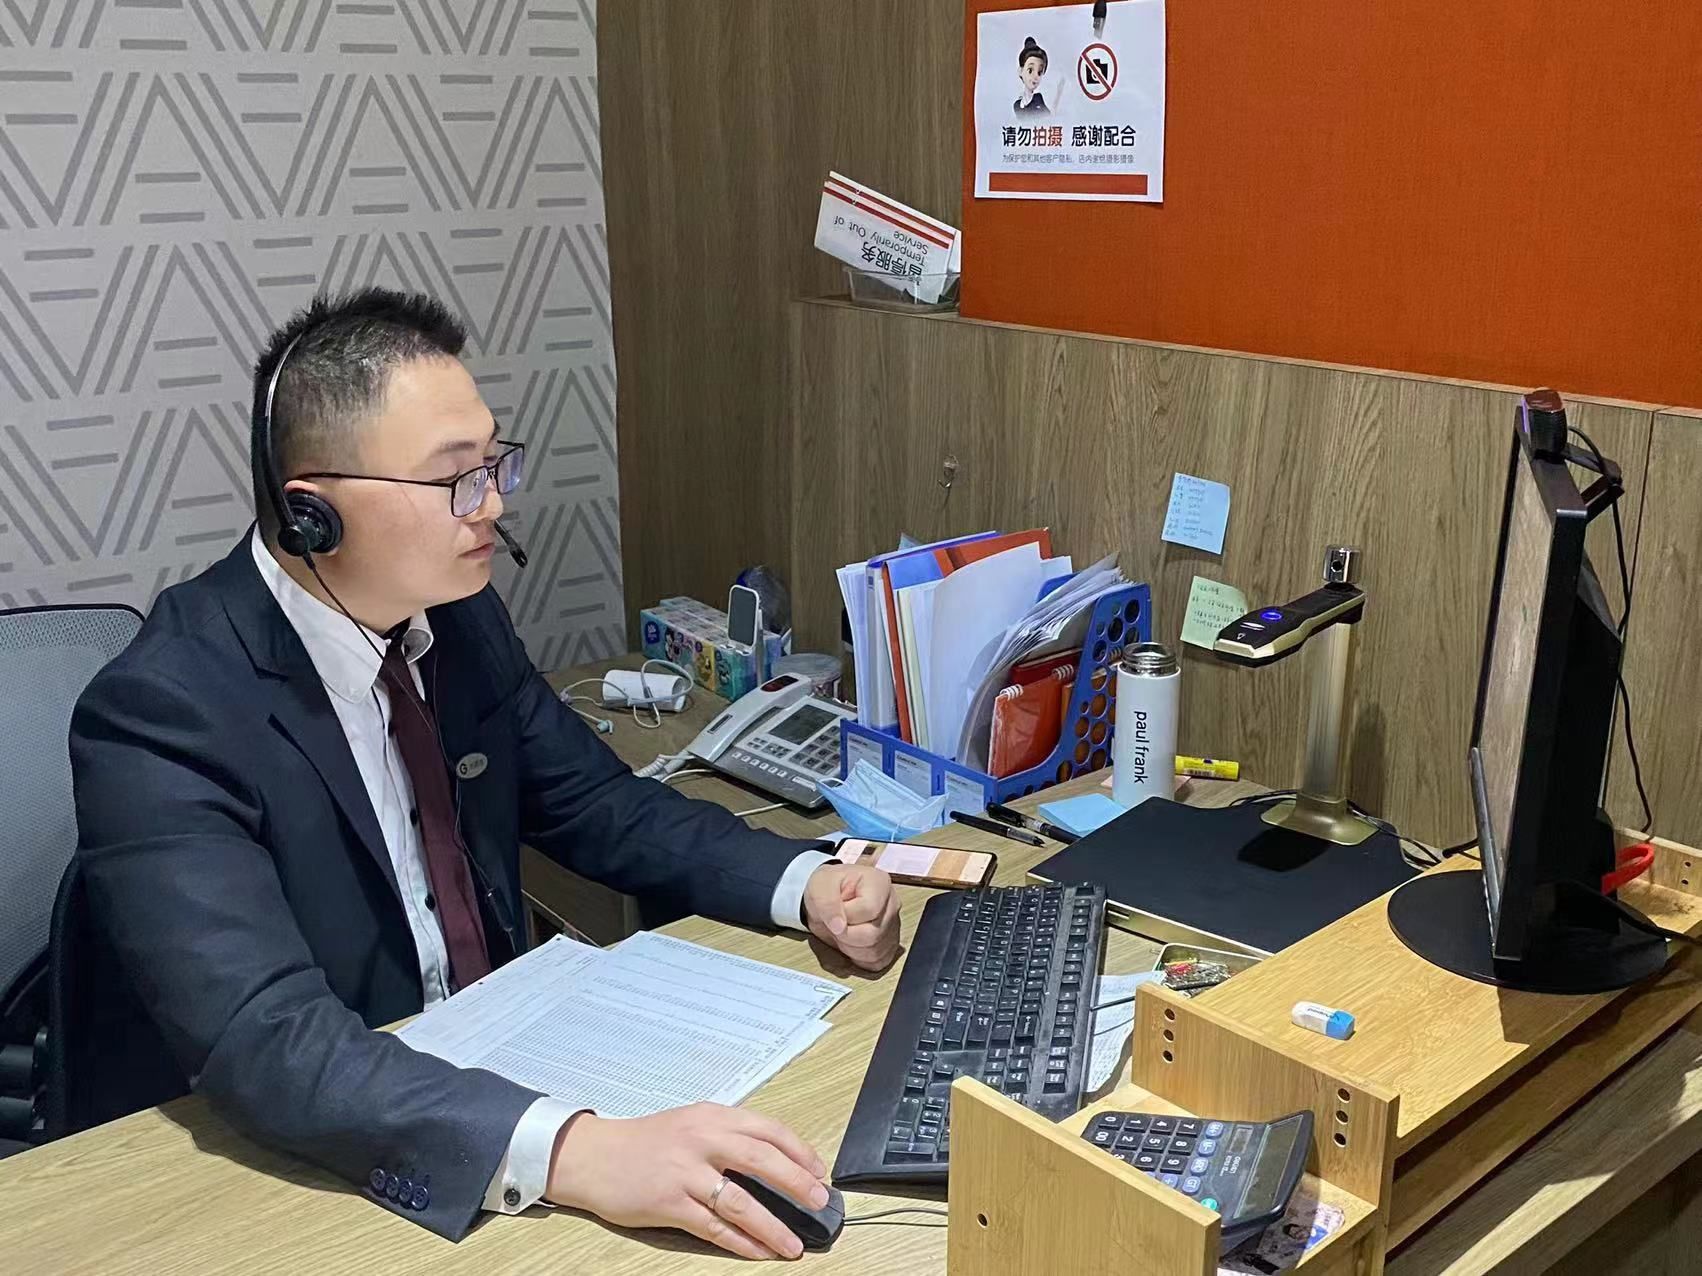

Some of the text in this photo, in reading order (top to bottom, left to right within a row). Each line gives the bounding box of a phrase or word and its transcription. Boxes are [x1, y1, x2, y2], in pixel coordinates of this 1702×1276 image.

[1002, 125, 1137, 147] 请勿拍摄 感谢配合
[833, 215, 925, 266] Temporarily Out of
[893, 230, 928, 255] Service
[1133, 711, 1150, 784] paul frank
